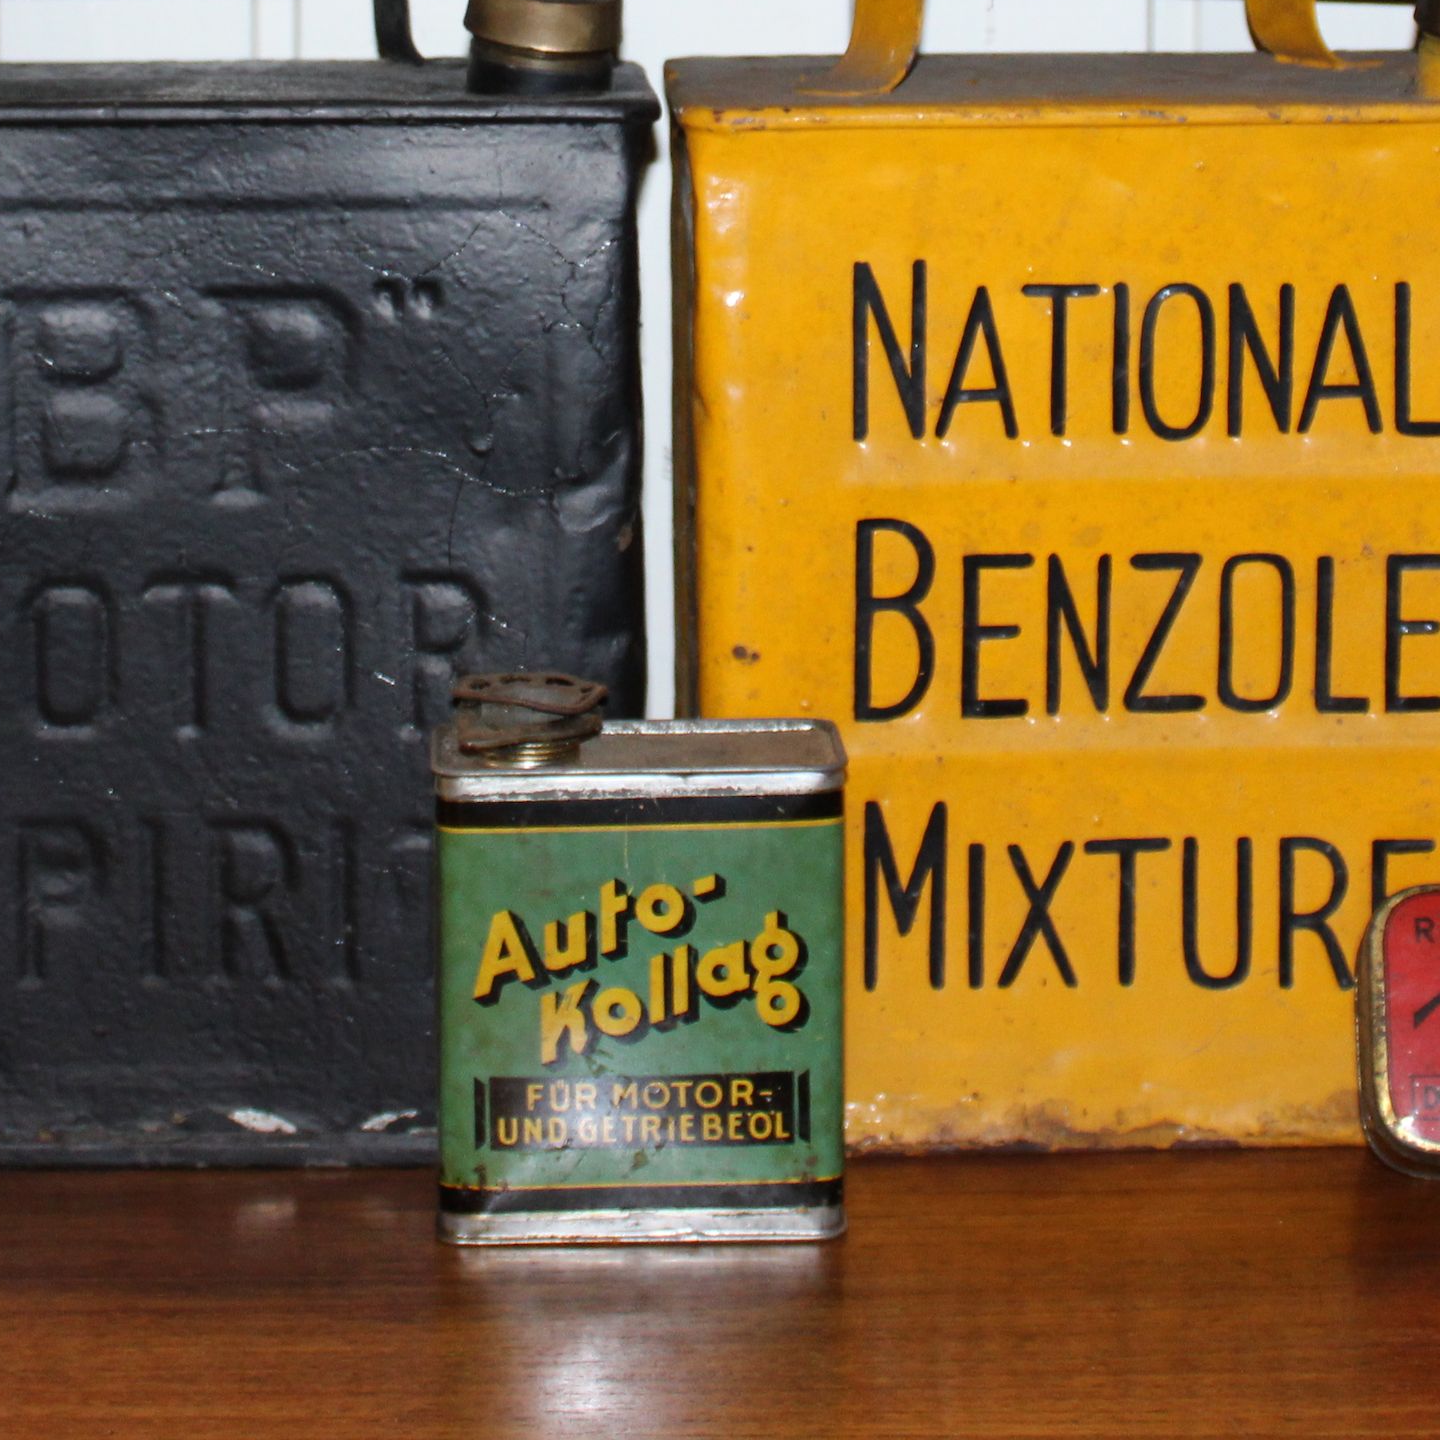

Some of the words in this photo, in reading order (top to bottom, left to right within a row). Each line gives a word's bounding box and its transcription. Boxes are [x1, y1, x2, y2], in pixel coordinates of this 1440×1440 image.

[472, 871, 727, 1008] Auto-
[539, 910, 812, 1066] Kollag
[497, 1116, 566, 1145] UND
[577, 1110, 790, 1144] GETRIEBEÖL
[525, 1079, 598, 1111] FÜR
